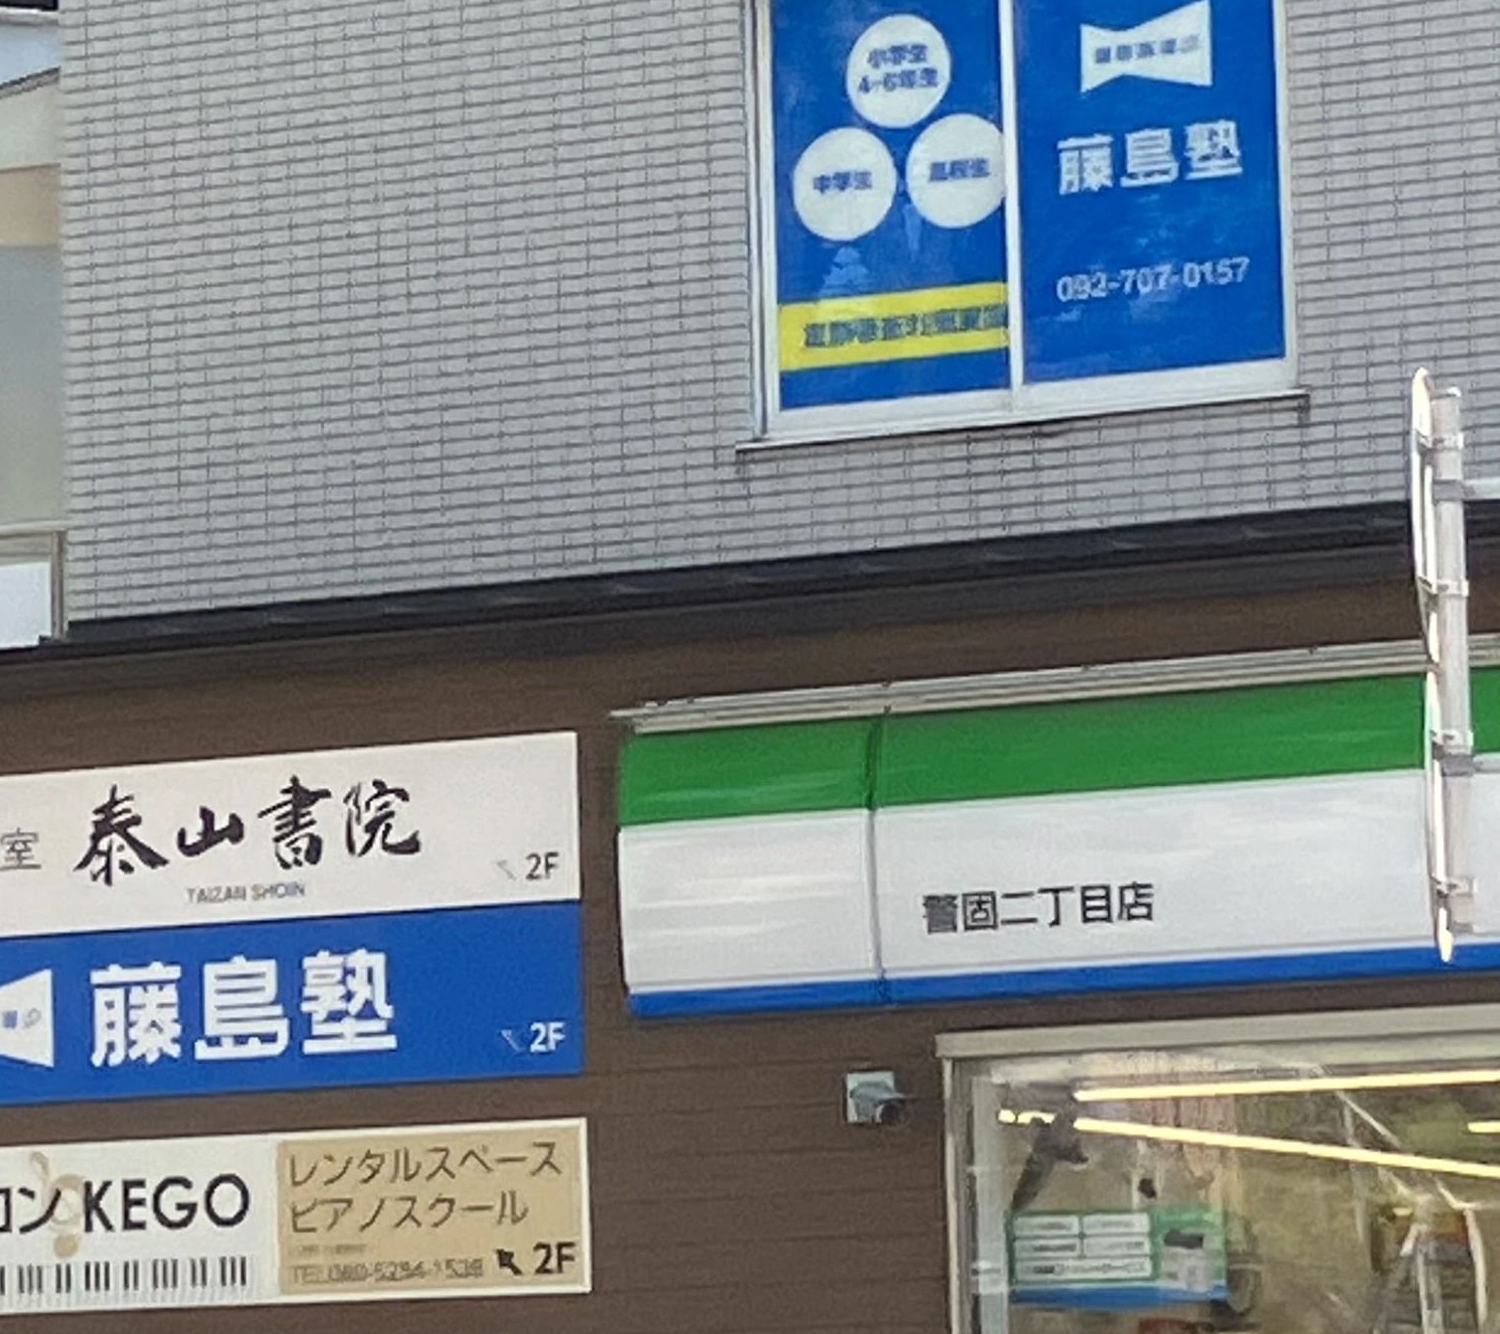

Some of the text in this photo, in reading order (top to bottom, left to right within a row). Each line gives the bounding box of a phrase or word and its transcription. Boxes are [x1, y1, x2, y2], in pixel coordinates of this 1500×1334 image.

[1057, 119, 1243, 195] 藤島塾
[72, 774, 421, 886] 泰山書院
[525, 851, 560, 880] 2F
[186, 886, 247, 904] TAIZAN
[923, 881, 1154, 934] 警固二丁目店
[90, 947, 398, 1067] 藤島塾
[529, 1021, 566, 1053] 2F
[290, 1141, 563, 1187] レンタルスペース
[83, 1172, 251, 1233] KEGO
[533, 1241, 577, 1275] 2F
